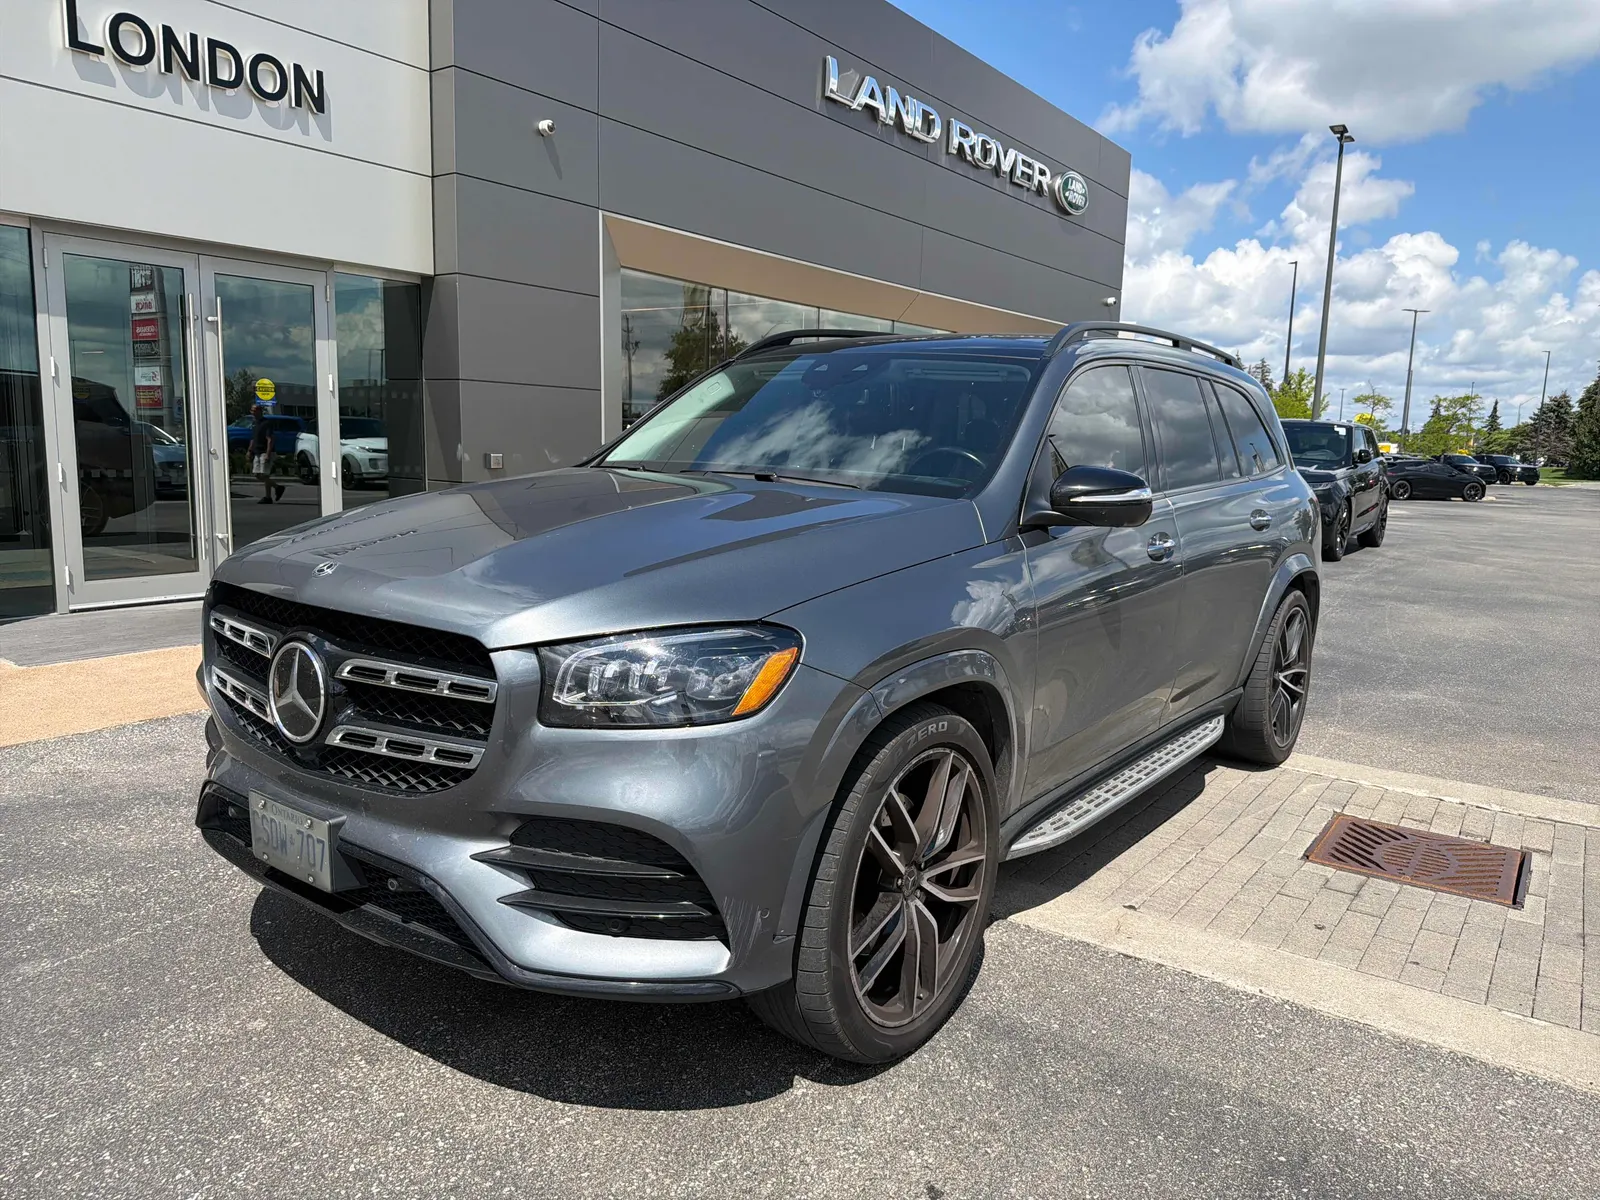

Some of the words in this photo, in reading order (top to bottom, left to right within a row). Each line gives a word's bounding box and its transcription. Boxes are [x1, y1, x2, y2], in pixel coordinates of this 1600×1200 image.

[62, 0, 326, 115] LONDON
[825, 55, 942, 144] LAND
[947, 117, 1051, 197] ROVER
[1067, 191, 1086, 207] ROVER
[1068, 178, 1083, 194] LAND
[906, 721, 948, 750] ZERO
[272, 803, 303, 825] ONTARIO
[296, 827, 325, 872] 707
